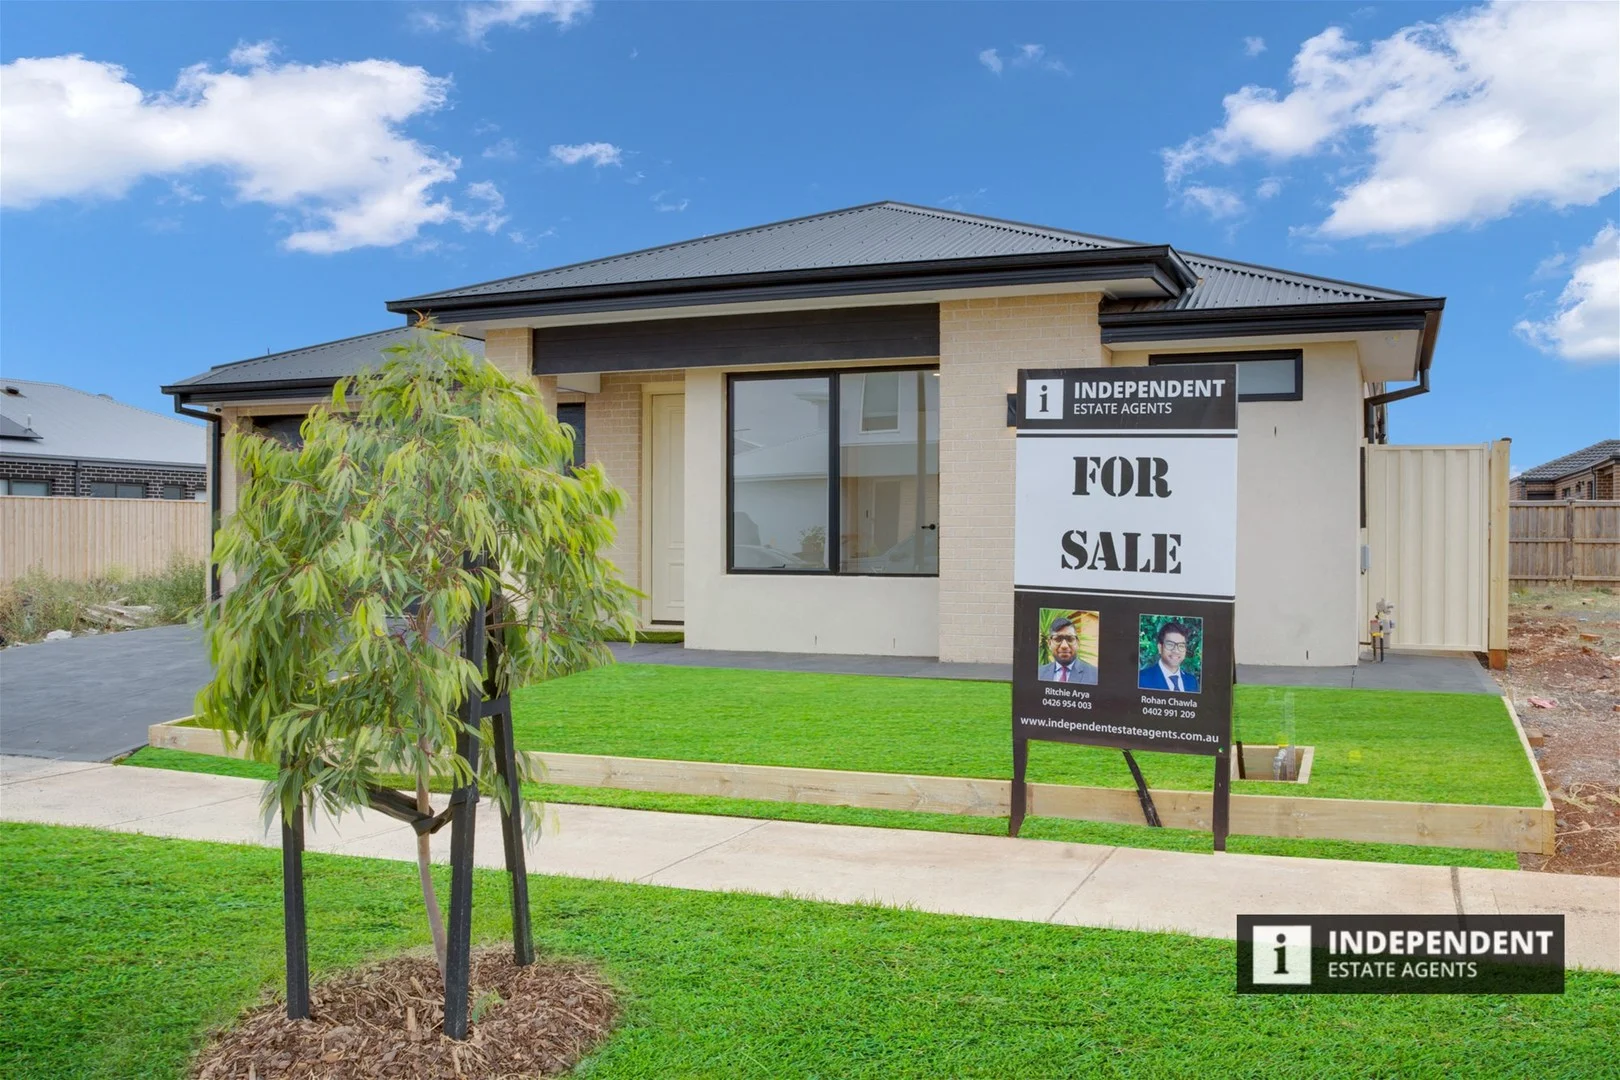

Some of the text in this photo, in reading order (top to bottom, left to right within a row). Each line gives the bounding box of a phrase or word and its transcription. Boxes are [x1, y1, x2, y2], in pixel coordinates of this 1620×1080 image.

[1074, 379, 1226, 399] INDEPENDENT
[1073, 402, 1173, 415] ESTATE AGENTS
[1072, 456, 1172, 498] FOR
[1061, 530, 1181, 574] SALE
[1045, 687, 1090, 700] Ritchie Arya
[1042, 698, 1092, 710] 0426 954 003
[1141, 695, 1198, 708] Rohan Chawla
[1142, 707, 1196, 719] 0402 991 209
[1020, 716, 1219, 743] www.independentestateagents.com.au
